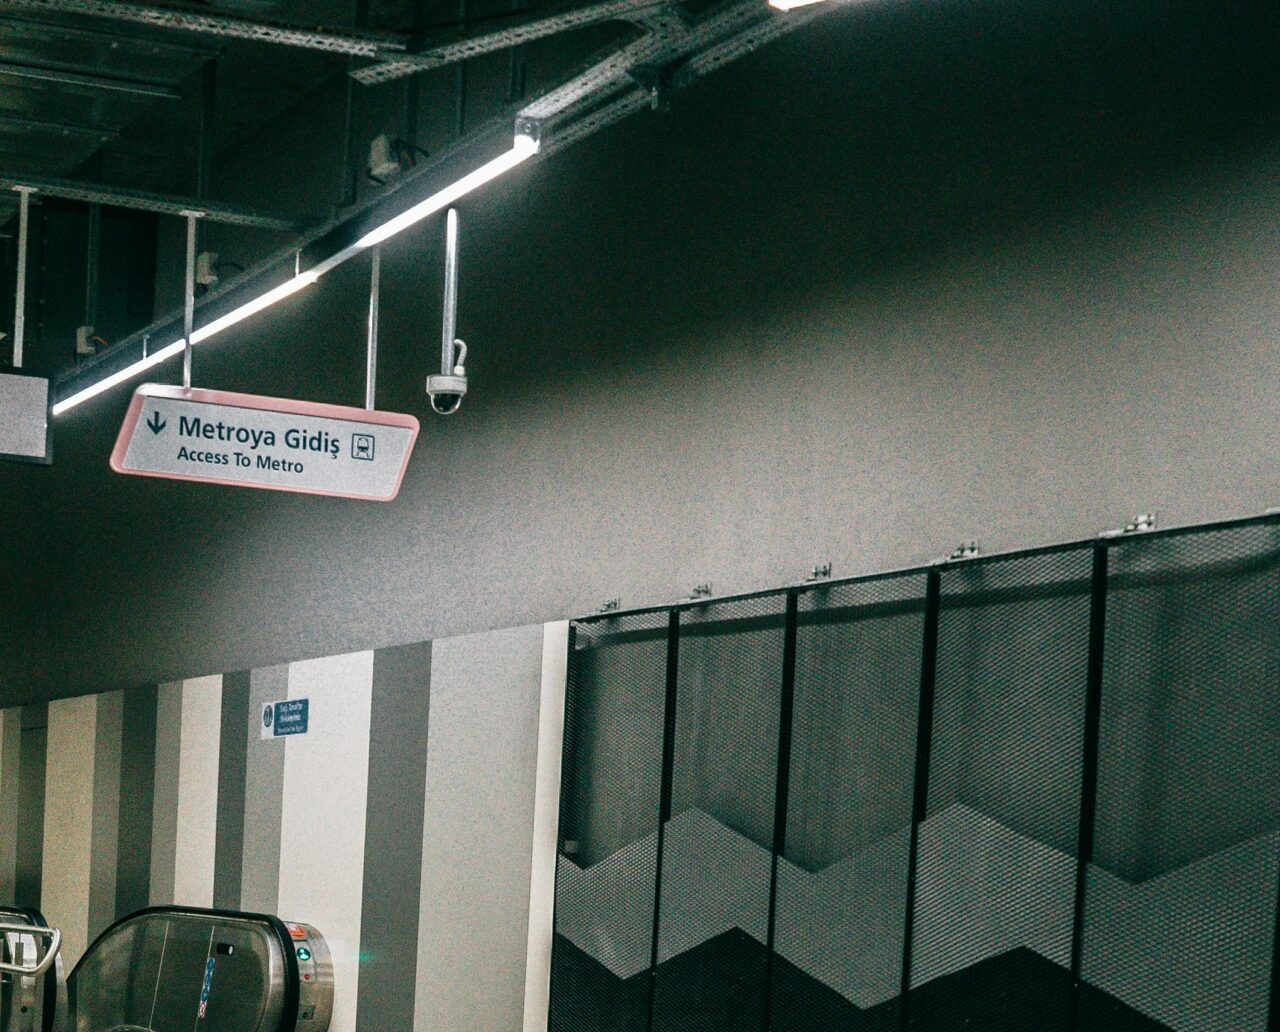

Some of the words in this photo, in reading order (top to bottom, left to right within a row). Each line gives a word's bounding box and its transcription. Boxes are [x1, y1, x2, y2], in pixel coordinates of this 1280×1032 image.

[179, 415, 276, 450] Metroya
[284, 428, 340, 460] Gidiş
[177, 446, 230, 466] Access
[233, 452, 252, 468] To
[256, 455, 304, 474] Metro
